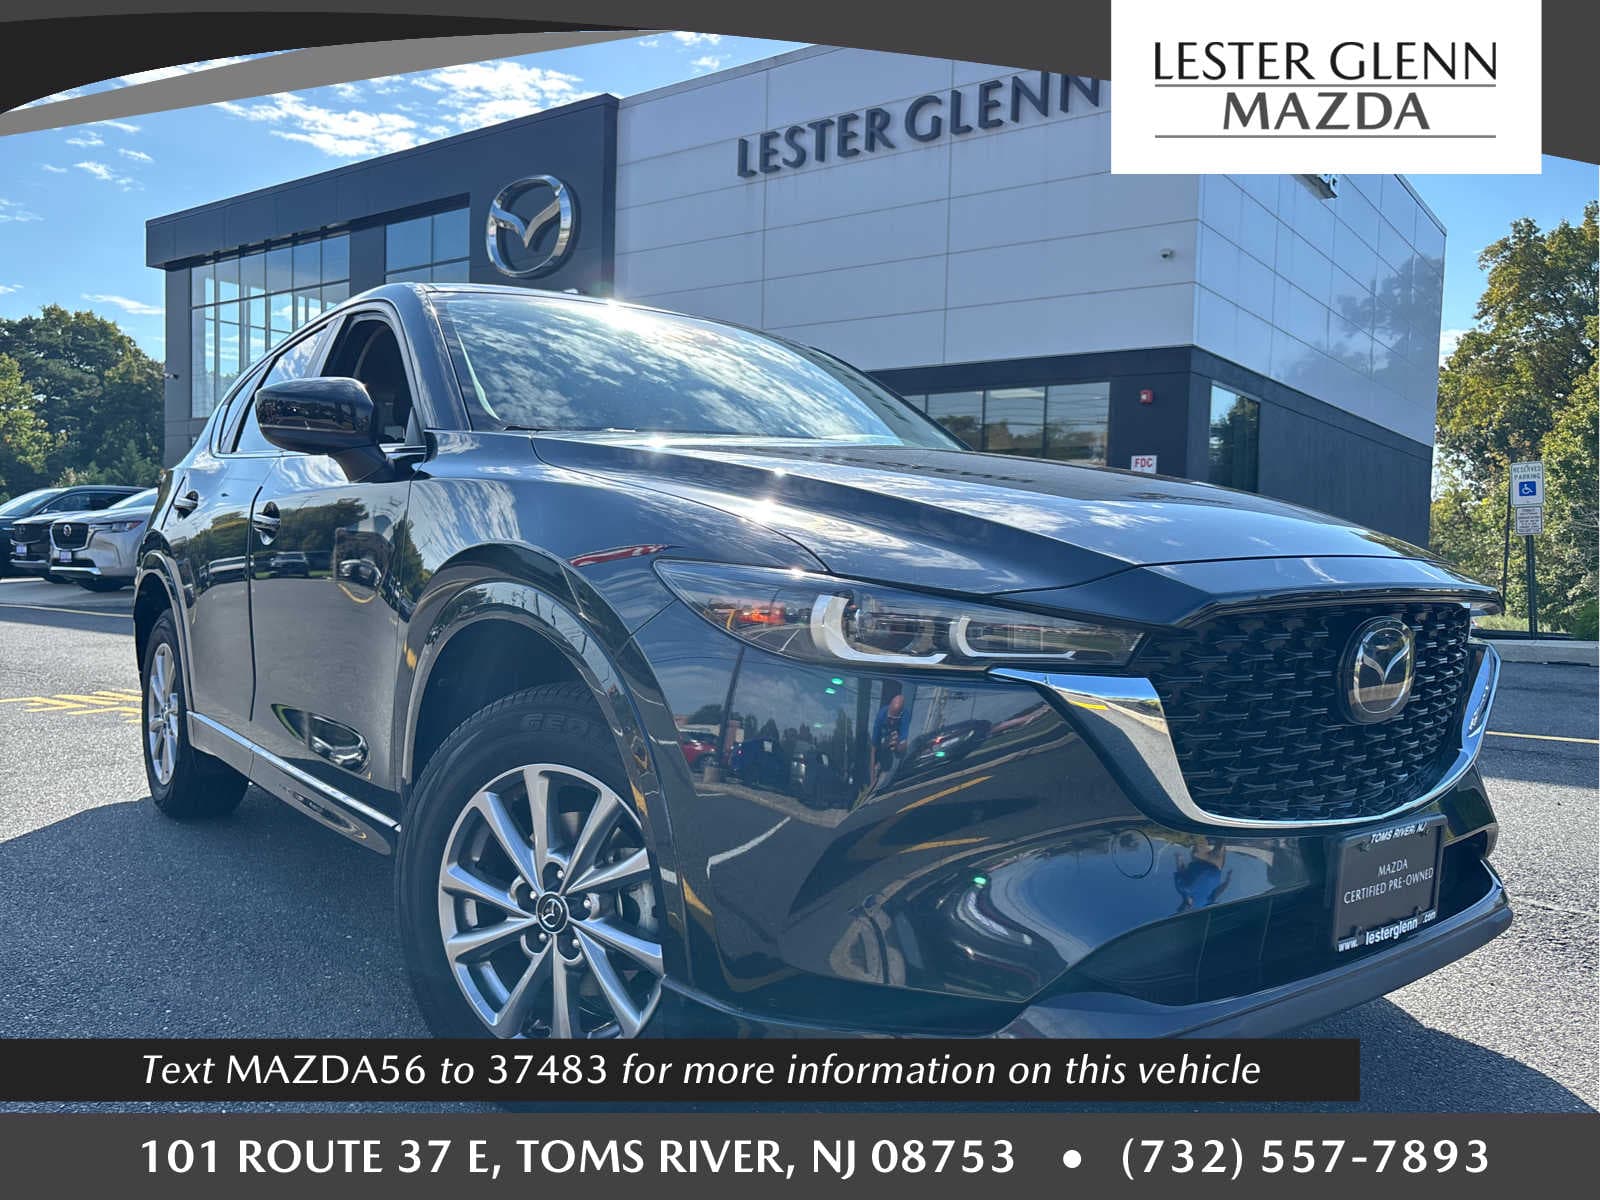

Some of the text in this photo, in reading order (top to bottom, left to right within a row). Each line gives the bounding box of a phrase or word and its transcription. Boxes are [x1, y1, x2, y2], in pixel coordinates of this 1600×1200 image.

[737, 72, 1100, 178] LESTER GLENN
[1135, 457, 1153, 468] FDC
[1378, 858, 1408, 876] MAZDA
[1344, 867, 1434, 904] CERTIFIED PRE-OWNED
[1365, 918, 1418, 946] lesterglenn
